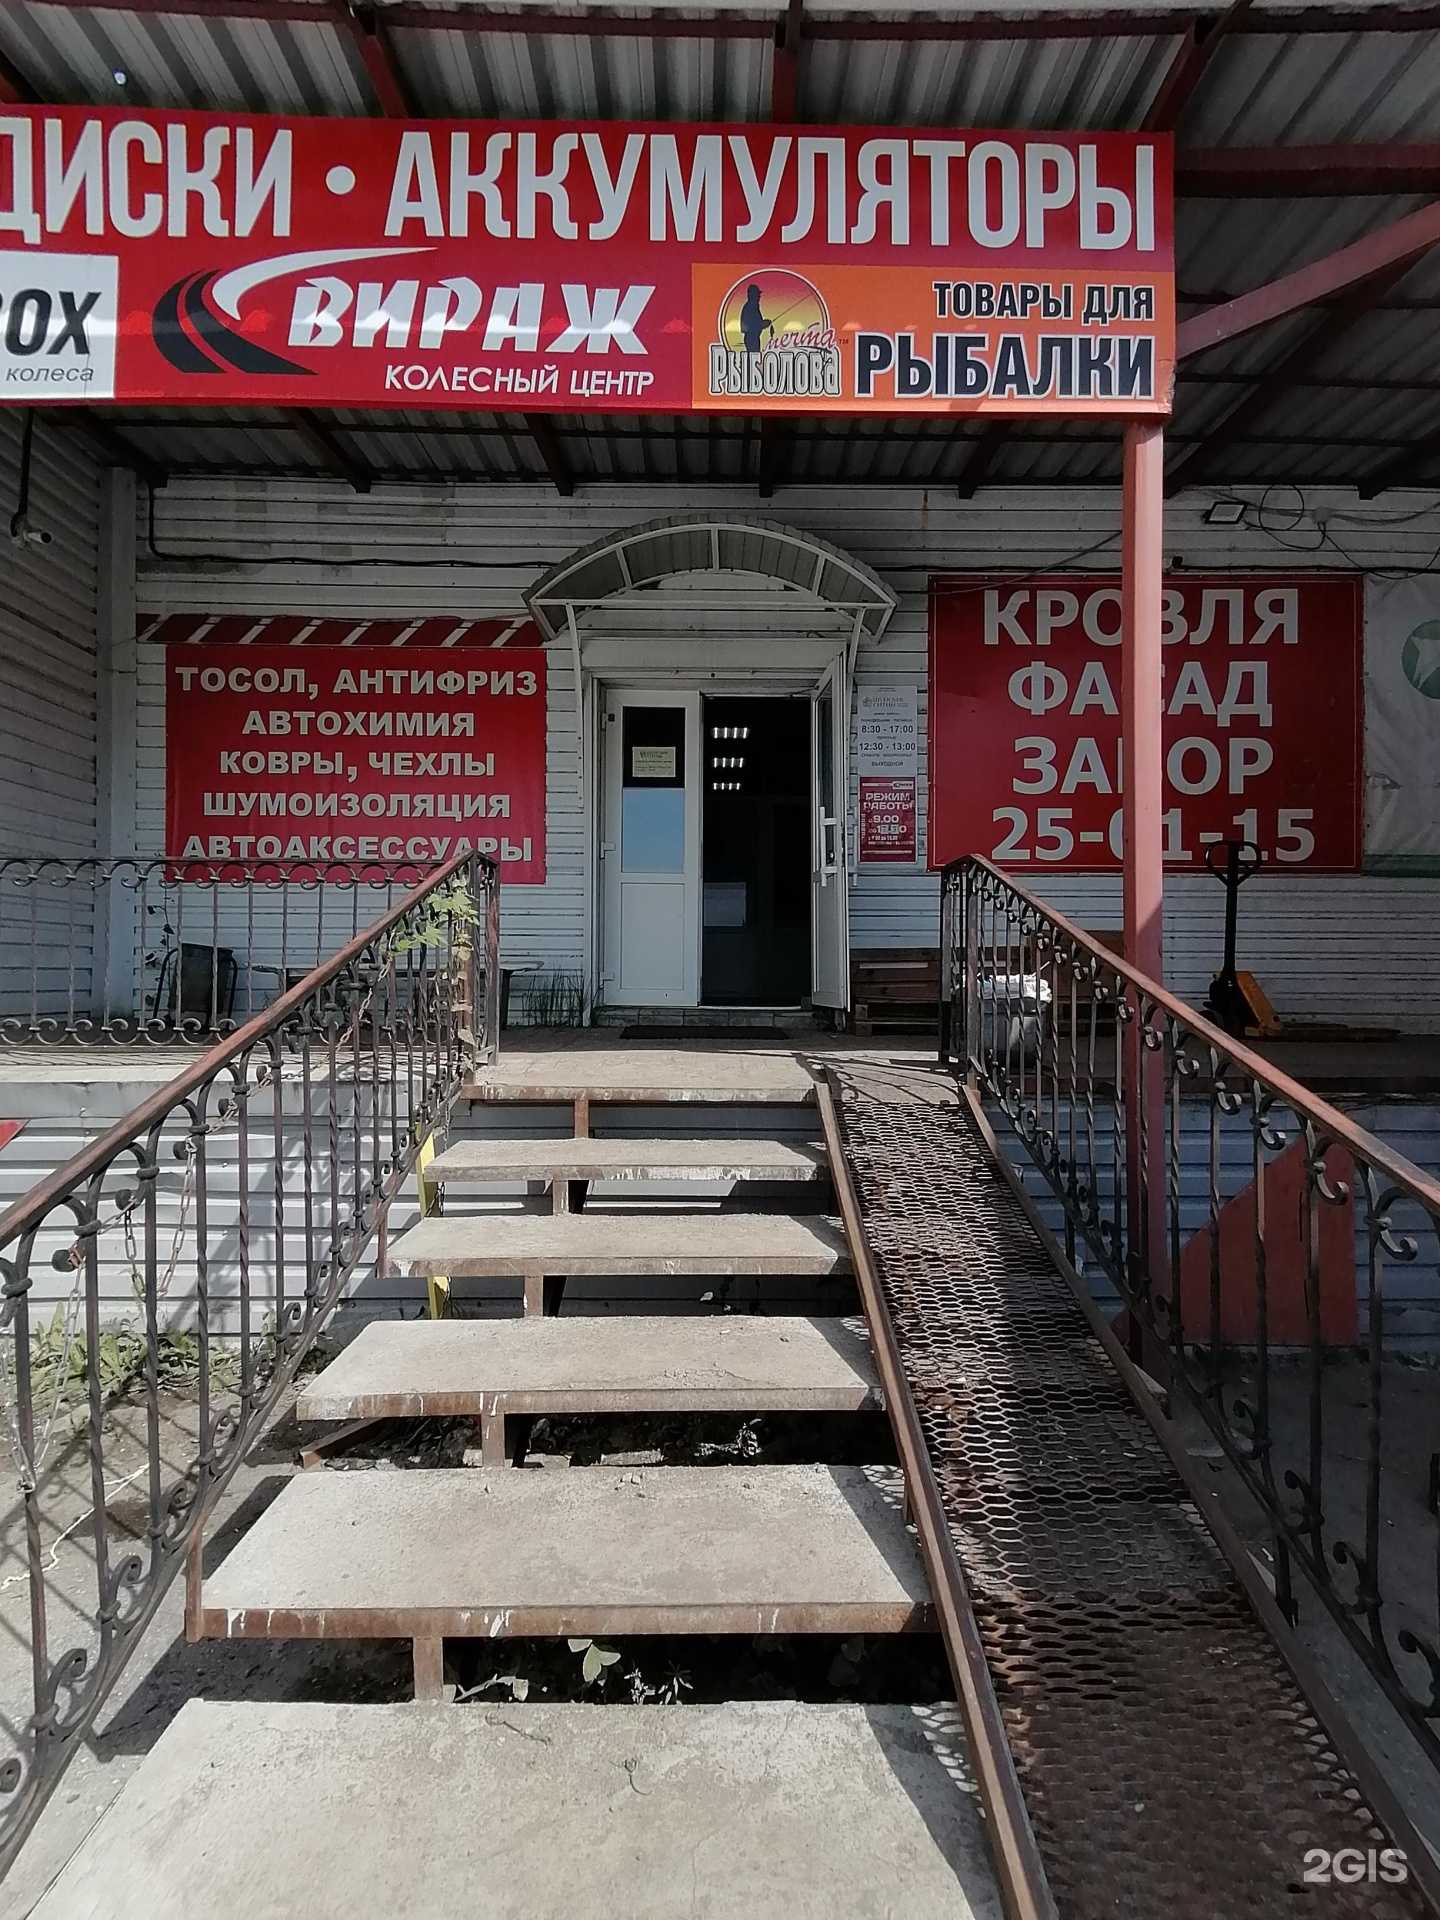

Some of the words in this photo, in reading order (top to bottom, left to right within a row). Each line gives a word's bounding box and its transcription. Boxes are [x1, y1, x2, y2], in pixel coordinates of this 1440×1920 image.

[0, 117, 292, 244] ДИСКИ
[384, 130, 1155, 252] АККУМУЛЯТОРЫ
[288, 277, 655, 354] ВИРАЖ
[932, 281, 1073, 320] ТОВАРЫ
[1081, 284, 1155, 326] ДЛЯ
[0, 289, 101, 356] OX
[6, 367, 94, 381] колеса
[385, 365, 558, 394] КОЛЕСНЫЙ
[570, 370, 654, 397] ЦЕНТР
[855, 332, 1155, 399] РЫБАЛКИ
[176, 667, 318, 699] ТОСОЛ,
[333, 669, 537, 695] АНТИФРИЗ
[1008, 661, 1273, 727] ФААД
[242, 711, 474, 736] АВТОХИМИЯ
[889, 725, 914, 733] 17:00
[859, 743, 883, 751] 12:30
[220, 752, 358, 782] КОВРЫ,
[369, 752, 495, 776] ЧЕХЛЫ
[1013, 737, 1274, 794] ЗАОР
[204, 793, 511, 822] ШУМОИЗОЛЯЦИЯ
[865, 793, 910, 801] РЕЖИМ
[183, 836, 532, 861] АВТОАКСЕССУАРЫ
